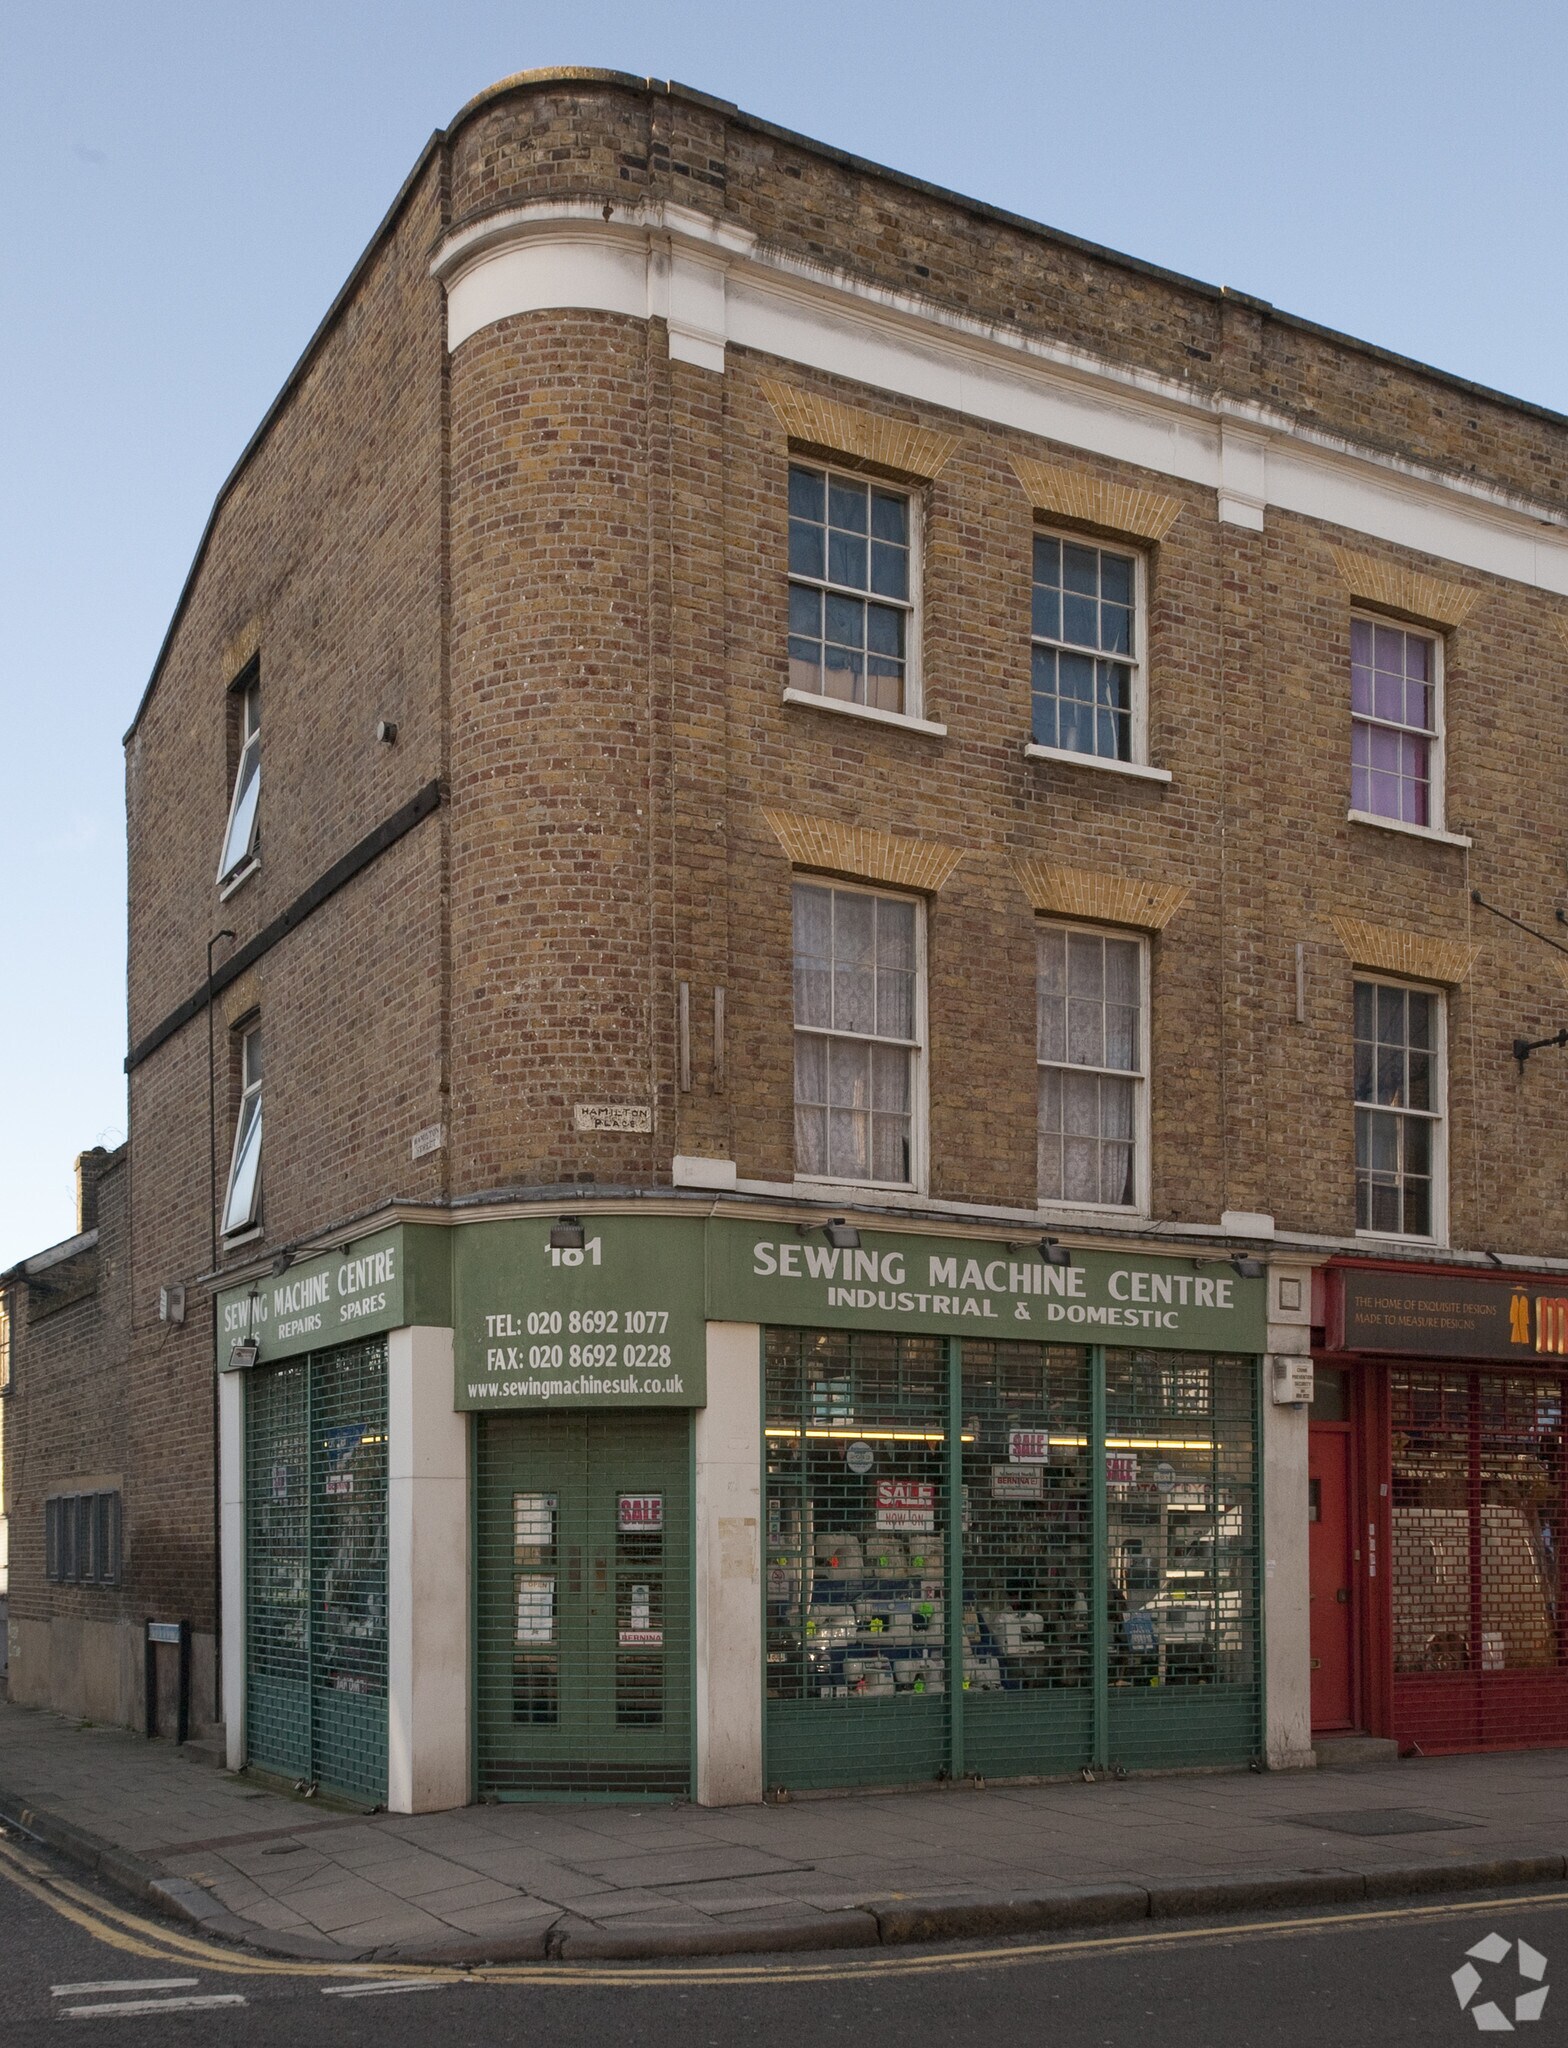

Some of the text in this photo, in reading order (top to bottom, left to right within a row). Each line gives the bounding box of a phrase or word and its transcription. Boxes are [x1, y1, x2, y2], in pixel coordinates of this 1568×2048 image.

[581, 1107, 648, 1117] HAMILTON
[594, 1119, 636, 1128] PLACE
[545, 1236, 601, 1267] 181
[274, 1271, 330, 1318] MACHINE
[337, 1247, 395, 1297] CENTRE
[753, 1242, 1234, 1309] SEWING MACHINE CENTRE
[828, 1287, 1179, 1329] INDUSTRIAL & DOMESTIC
[1355, 1296, 1497, 1316] THE HOME OF EXQUISITE DESIGNS
[231, 1292, 386, 1352] SAS REPAIRS SPARES
[486, 1311, 669, 1337] TEL: 020 8692 1077
[1355, 1313, 1476, 1330] MADE TO MEASURE DESIGNS
[487, 1344, 671, 1371] FAX: 020 8692 0228
[468, 1374, 684, 1400] www.sewingmachinesuk.co.uk
[1013, 1432, 1044, 1457] SALE
[880, 1481, 932, 1505] SALE
[621, 1500, 661, 1525] SALE
[885, 1513, 924, 1526] NOW ON
